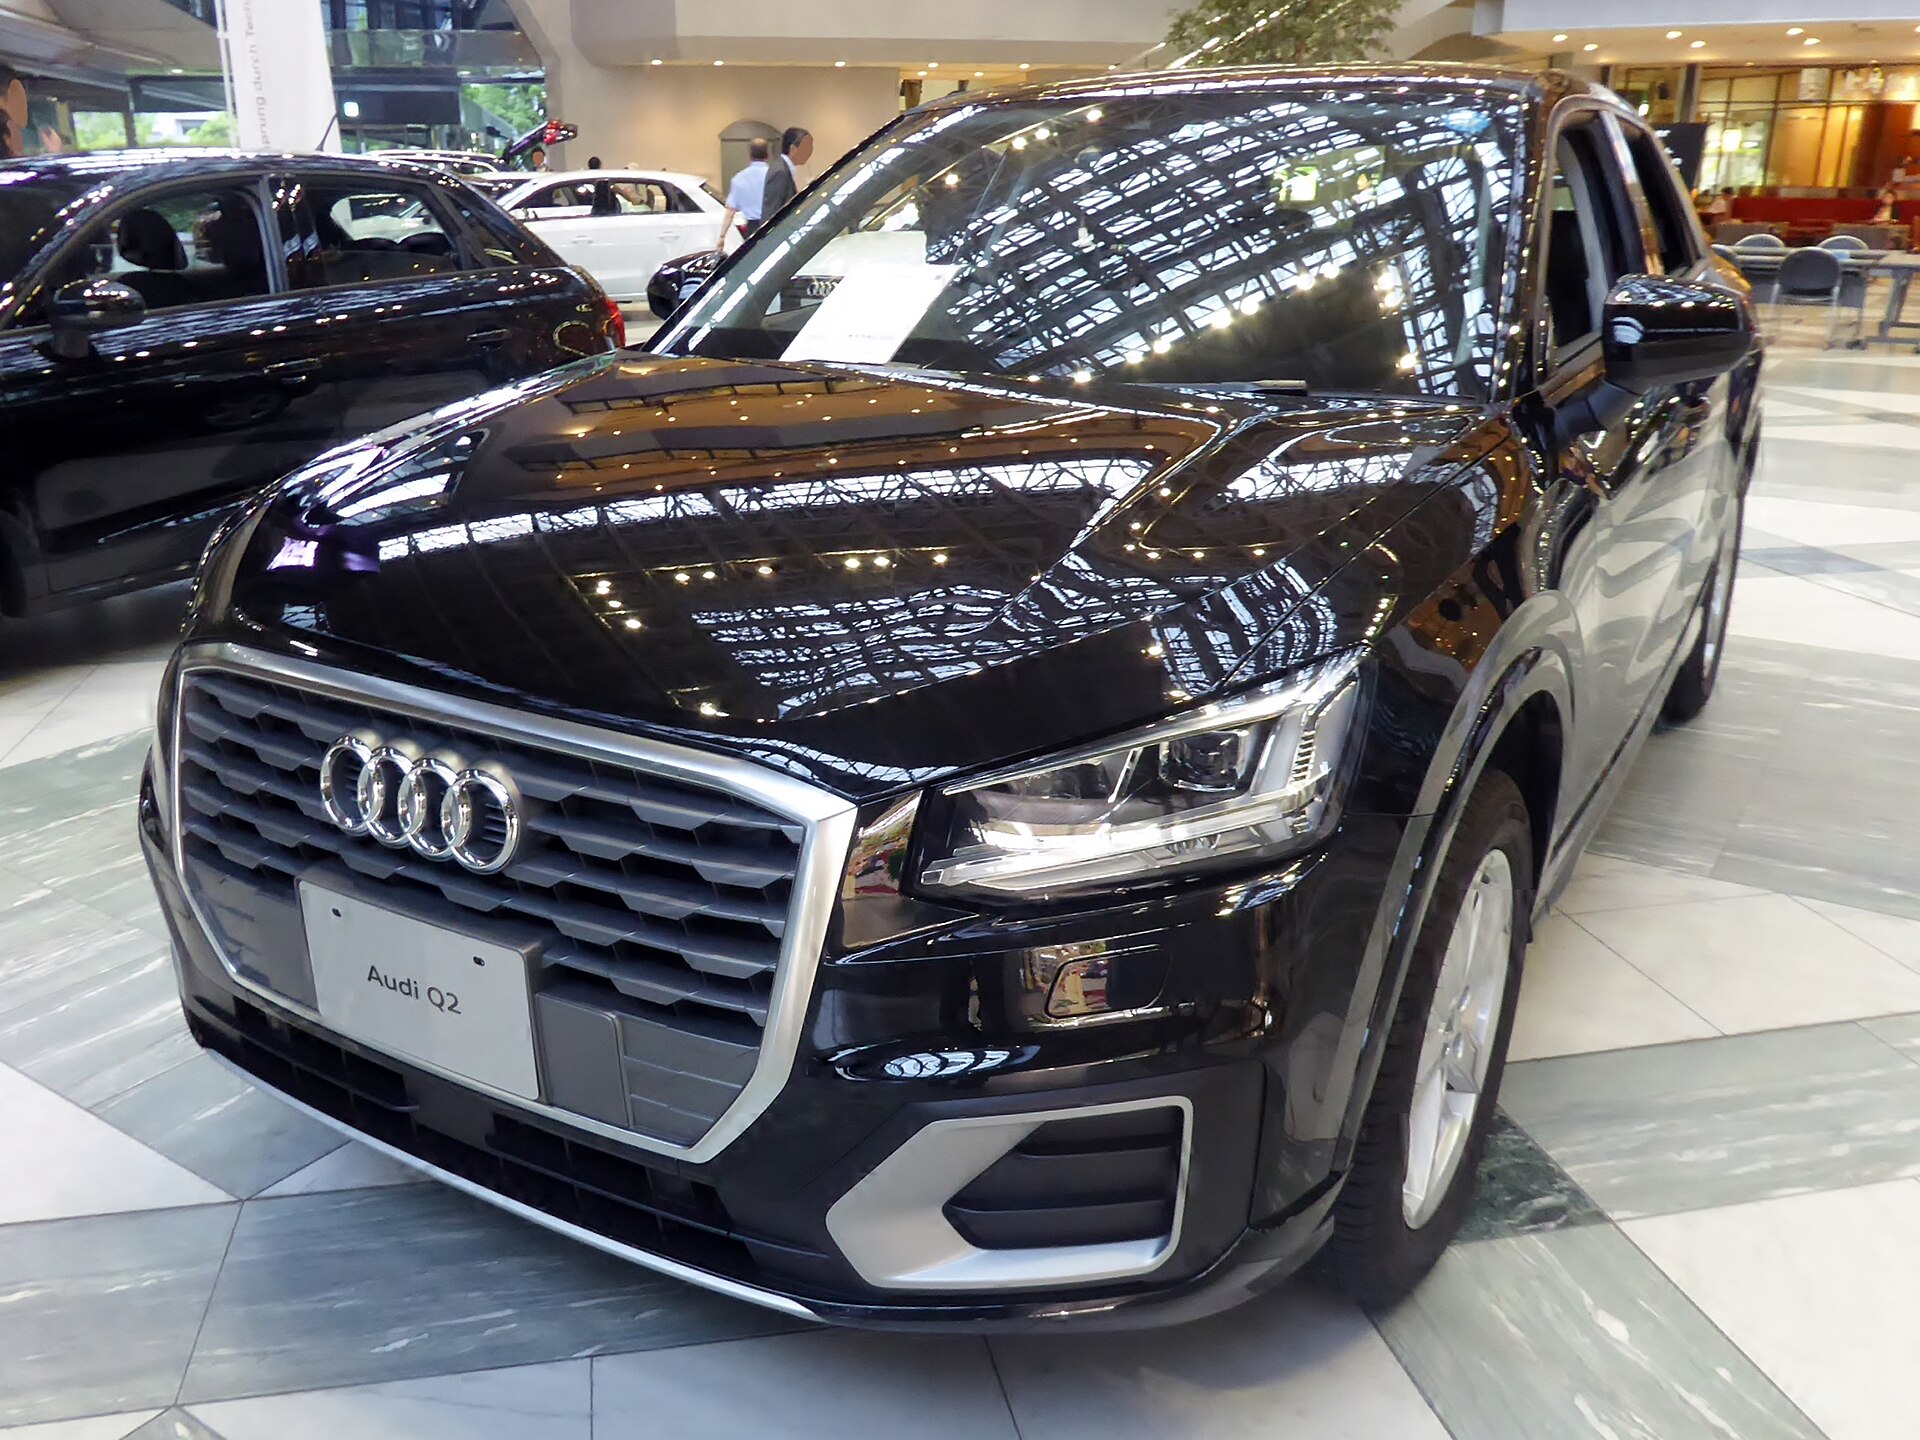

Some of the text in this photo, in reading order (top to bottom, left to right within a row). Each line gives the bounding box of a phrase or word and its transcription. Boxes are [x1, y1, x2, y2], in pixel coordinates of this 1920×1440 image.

[243, 0, 271, 150] prung durch Tech
[367, 965, 462, 1014] Audi Q2
